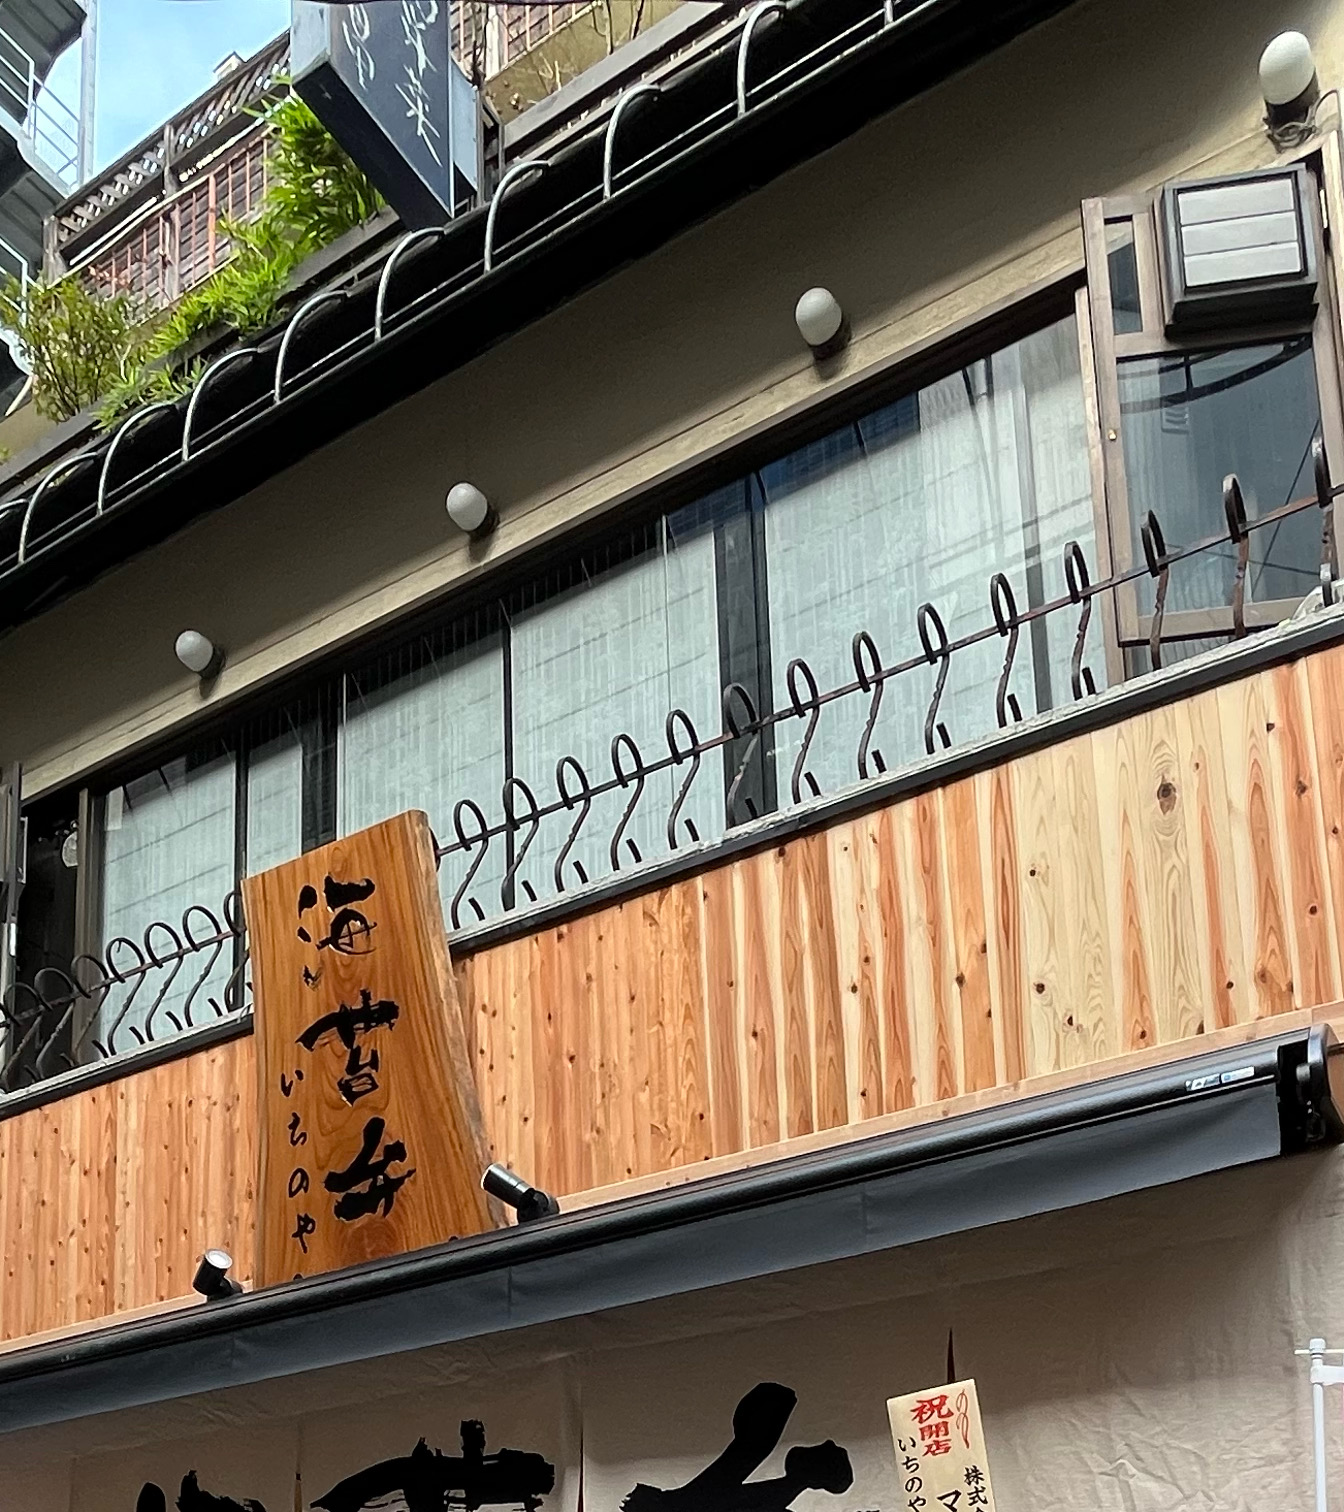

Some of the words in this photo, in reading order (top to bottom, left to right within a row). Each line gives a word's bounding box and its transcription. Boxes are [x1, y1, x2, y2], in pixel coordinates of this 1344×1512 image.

[295, 874, 416, 1221] 海苔弁
[281, 1068, 316, 1253] いちのや
[910, 1395, 954, 1456] 祝開店
